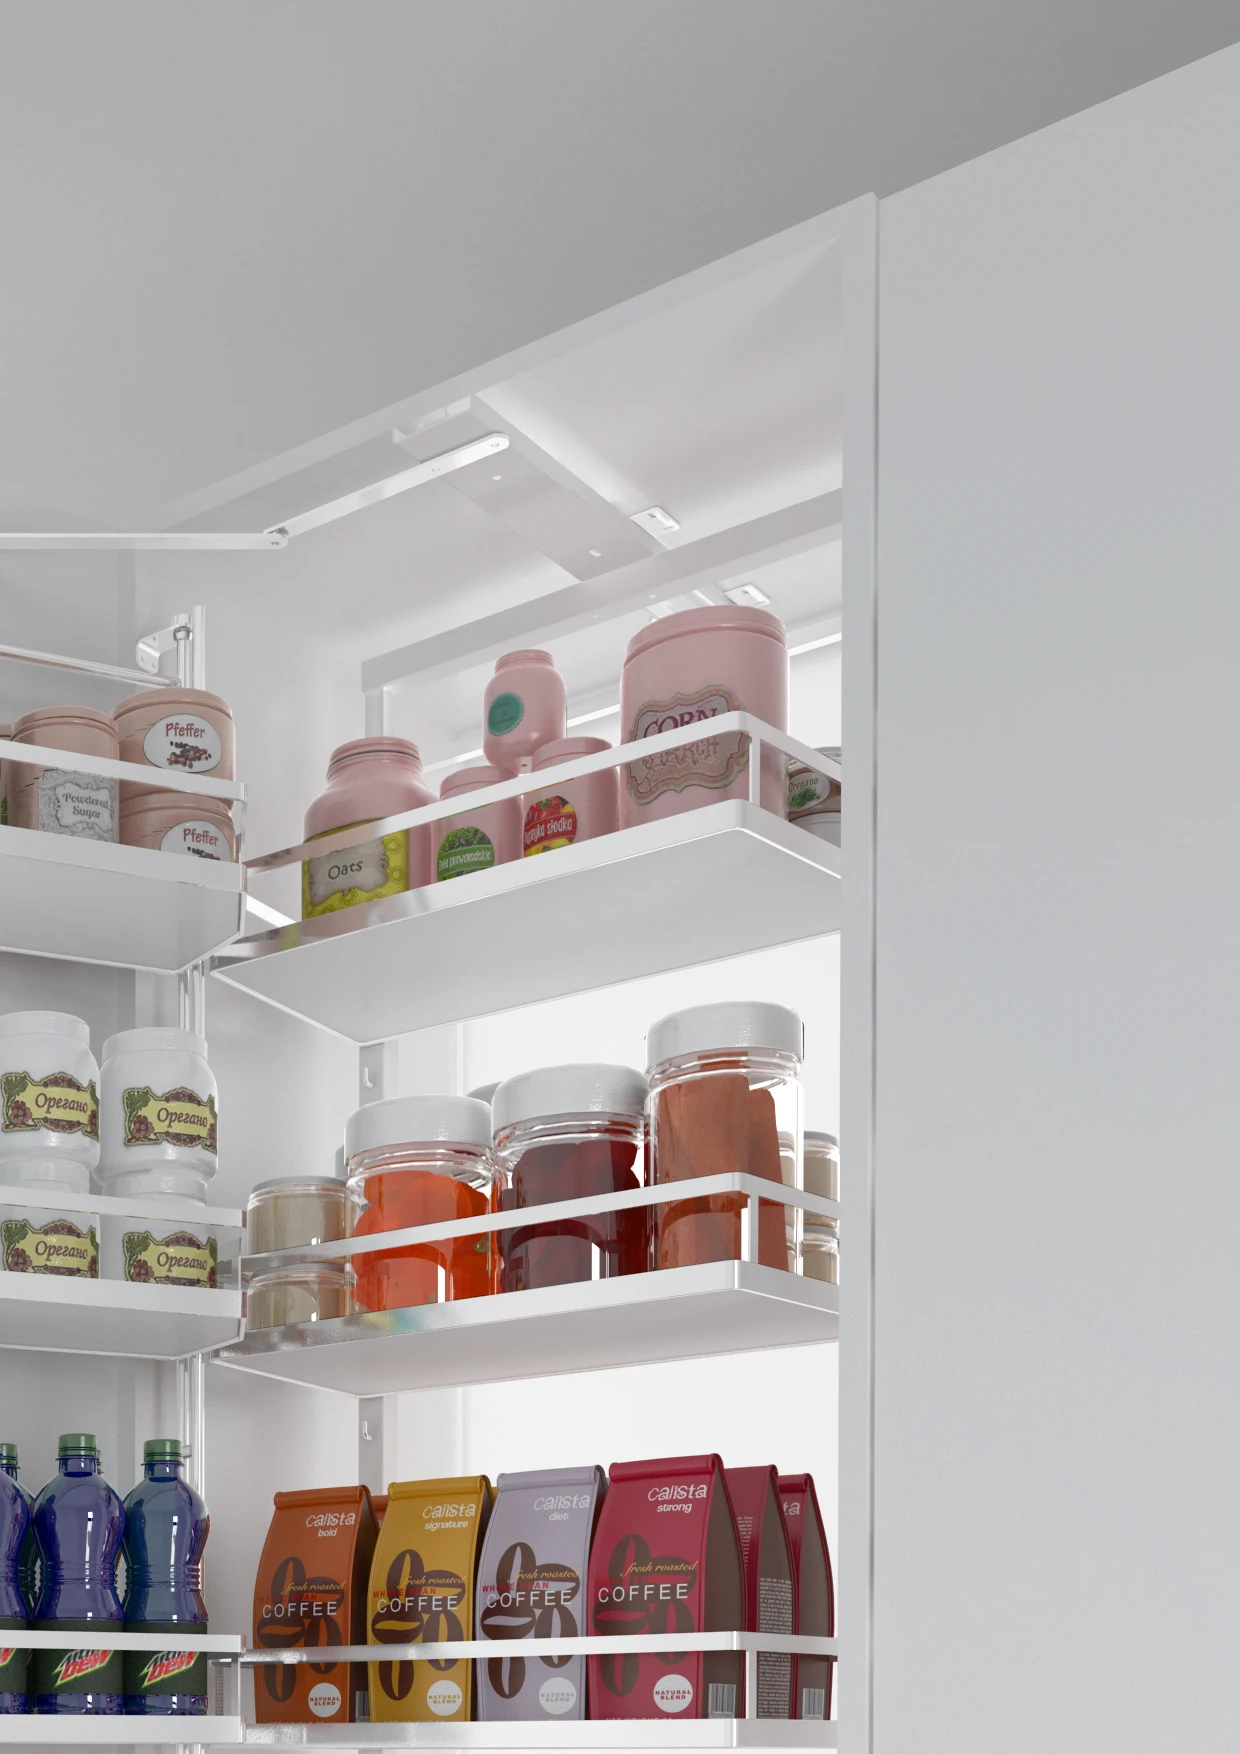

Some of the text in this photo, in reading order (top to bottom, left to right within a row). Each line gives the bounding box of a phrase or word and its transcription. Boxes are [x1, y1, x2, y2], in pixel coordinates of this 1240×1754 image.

[165, 722, 206, 738] Pfeffer
[62, 793, 108, 809] Powdered
[72, 806, 101, 819] Sugar
[183, 828, 219, 846] Pfeffer
[328, 860, 364, 880] Oats
[35, 1093, 88, 1114] Орегано
[157, 1108, 208, 1128] Орегано
[35, 1240, 88, 1261] Орегано
[157, 1252, 208, 1274] Орегано
[647, 1484, 708, 1502] Calista
[534, 1494, 590, 1511] Calista
[657, 1503, 693, 1514] strong
[422, 1503, 476, 1519] Calista
[549, 1511, 569, 1521] diet
[306, 1512, 355, 1528] Calista
[424, 1520, 469, 1531] signature
[318, 1528, 337, 1537] bold
[507, 1568, 583, 1584] fresh roasted
[620, 1560, 699, 1577] fresh roasted
[281, 1581, 347, 1595] fresh roasted
[397, 1575, 466, 1590] fresh roasted
[481, 1581, 549, 1593] WHOLE BEAN
[373, 1587, 436, 1598] WHOLE BEAN
[486, 1590, 572, 1609] COFFEE
[598, 1583, 688, 1603] COFFEE
[262, 1601, 337, 1619] COFFEE
[377, 1596, 458, 1614] COFFEE
